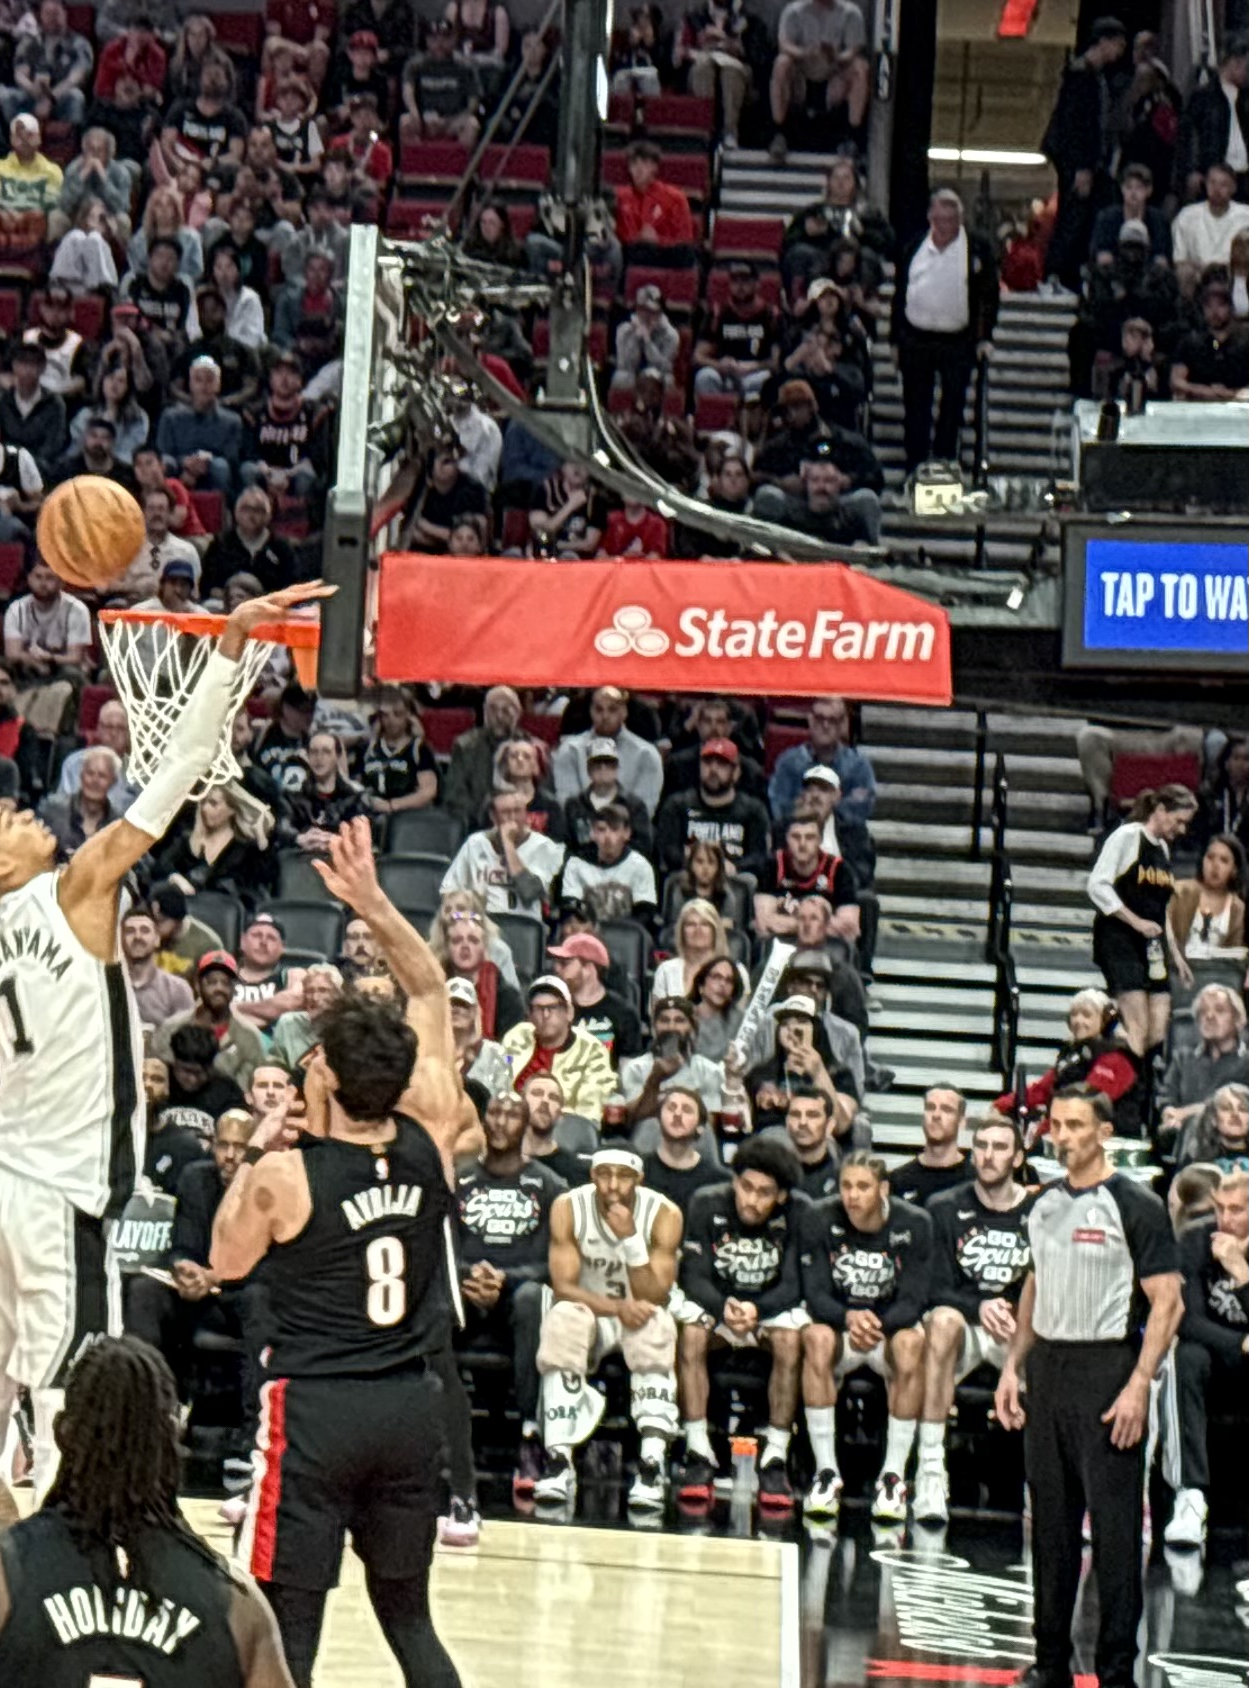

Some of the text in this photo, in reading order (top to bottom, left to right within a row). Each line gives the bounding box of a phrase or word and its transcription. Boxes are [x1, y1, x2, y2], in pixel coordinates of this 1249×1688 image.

[1101, 572, 1249, 620] TAP TO WA
[341, 1184, 423, 1231] AVDIJA
[465, 1194, 535, 1228] Spurs
[113, 1219, 173, 1252] LAYOFF
[366, 1235, 406, 1326] 8
[43, 1583, 200, 1655] HOLIDAY
